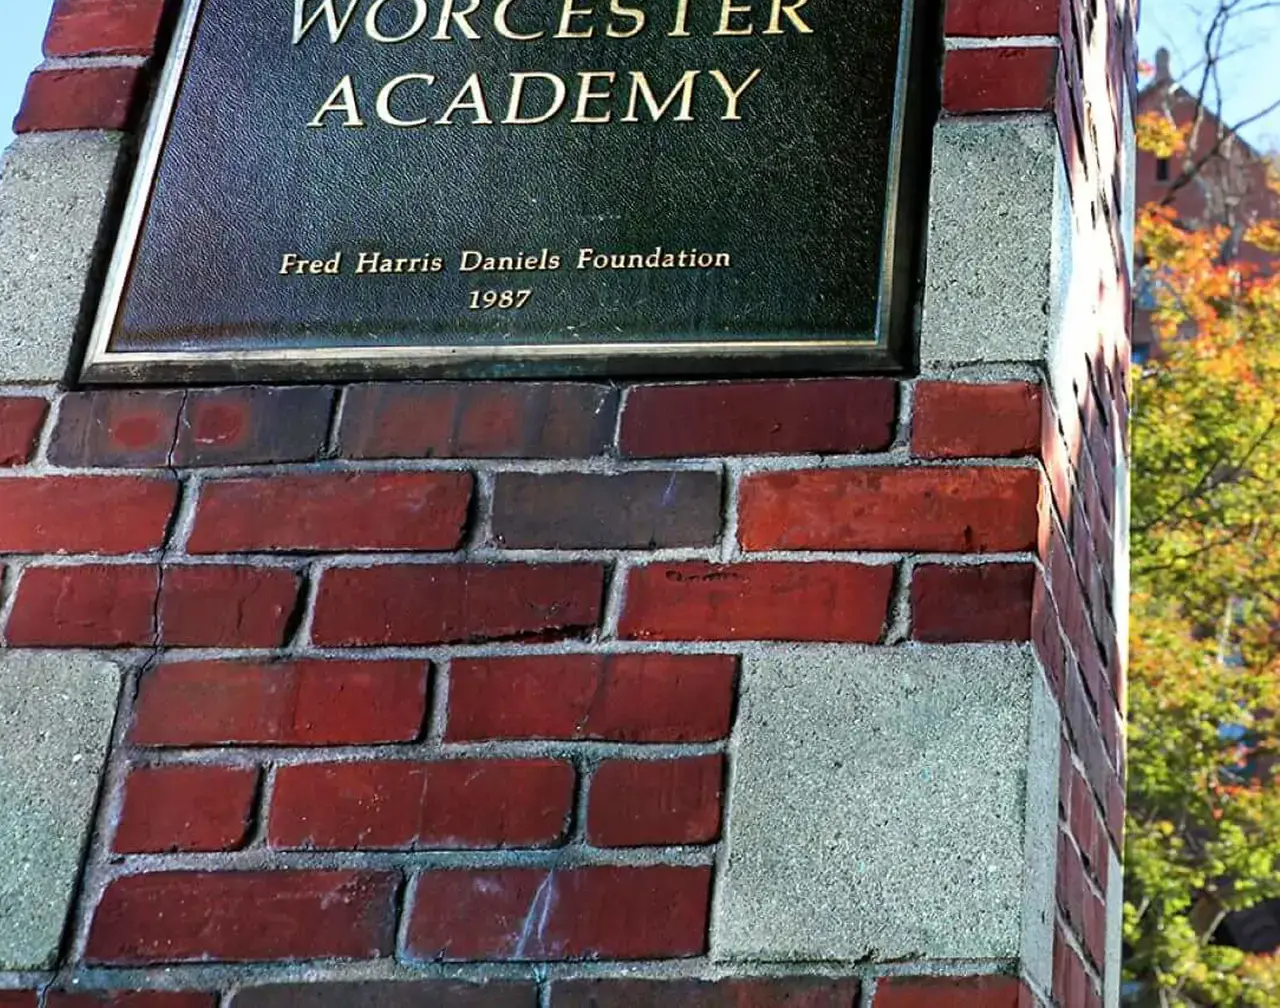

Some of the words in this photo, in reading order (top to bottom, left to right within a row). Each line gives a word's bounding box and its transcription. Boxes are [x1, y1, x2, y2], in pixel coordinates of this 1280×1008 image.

[307, 67, 763, 128] ACADEMY
[279, 251, 340, 276] Fred
[355, 250, 442, 274] Harris
[459, 249, 561, 273] Daniels
[576, 247, 731, 270] Foundation
[467, 290, 532, 310] 1987
